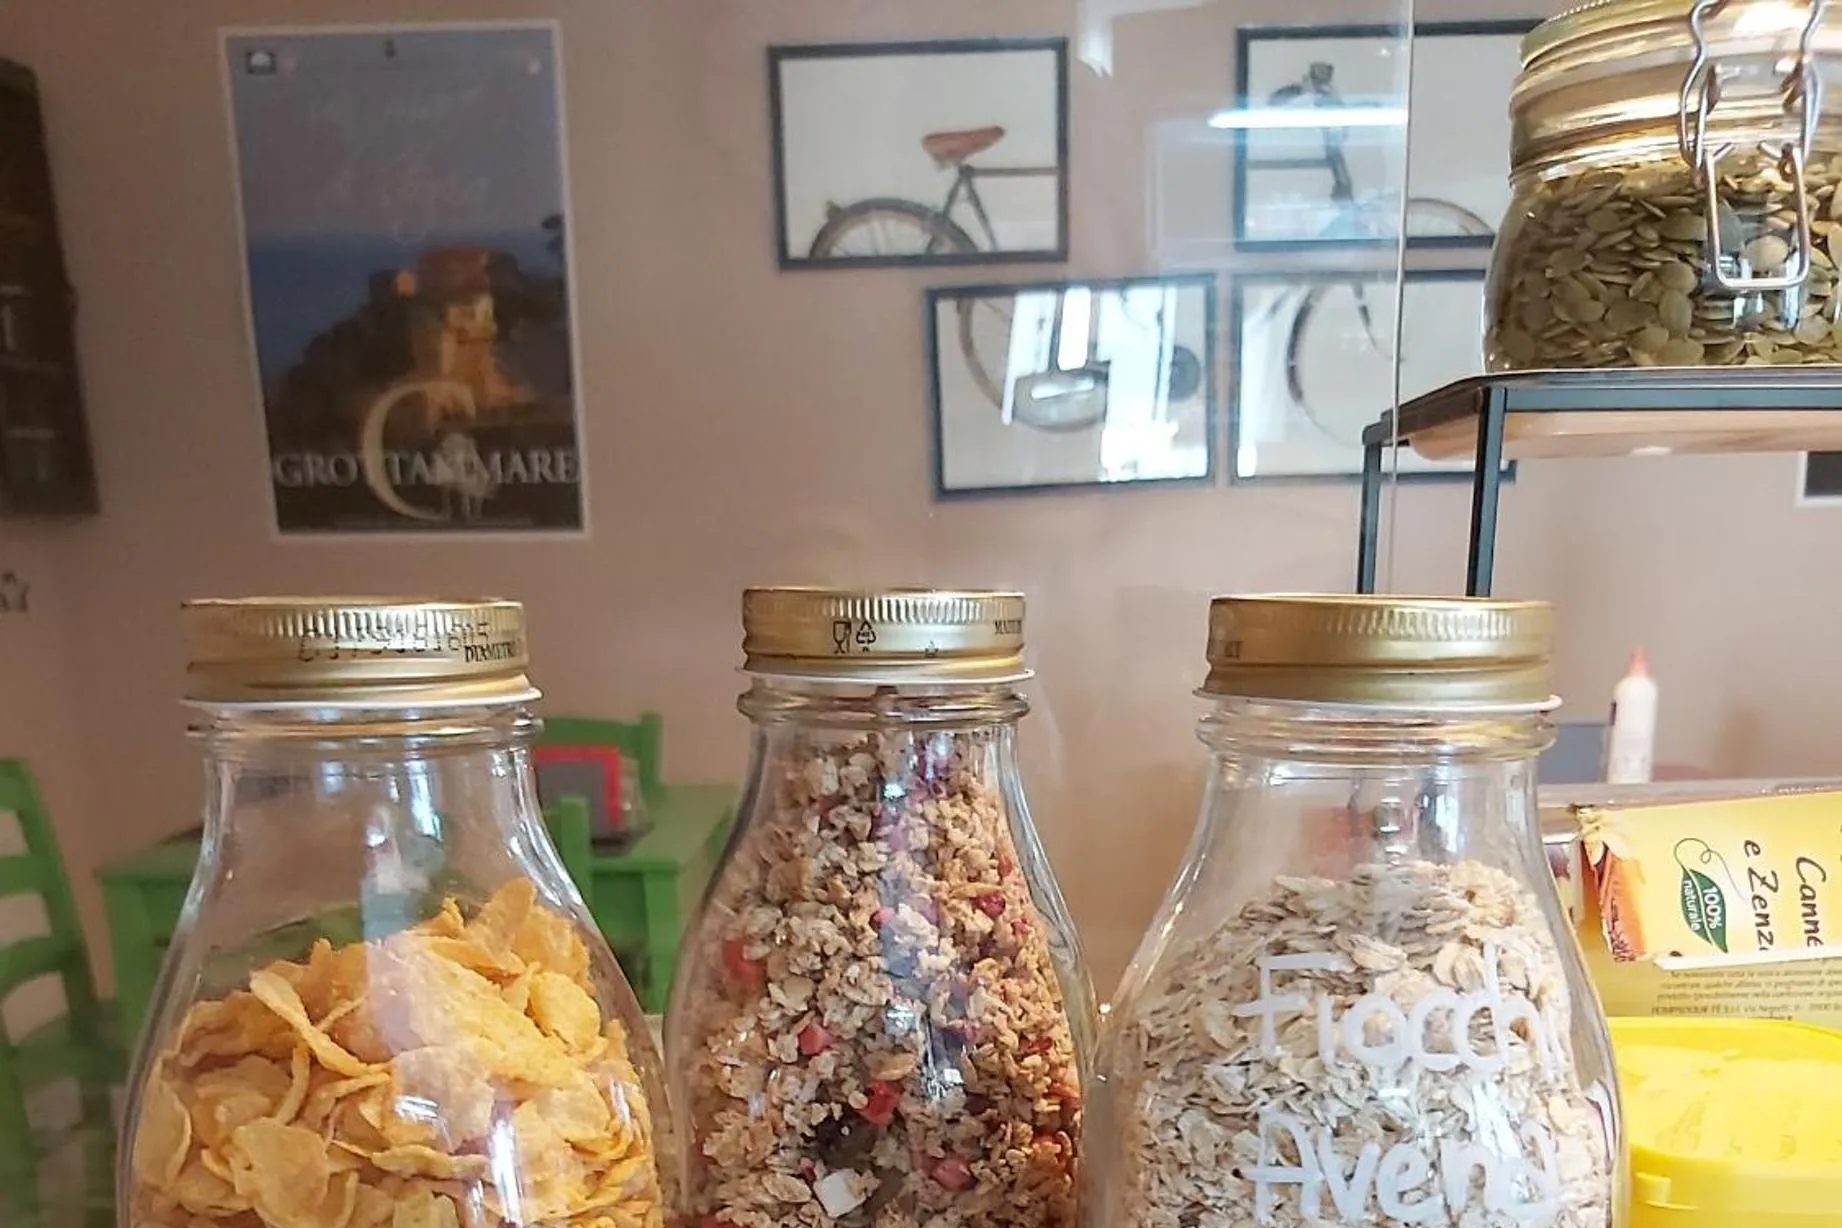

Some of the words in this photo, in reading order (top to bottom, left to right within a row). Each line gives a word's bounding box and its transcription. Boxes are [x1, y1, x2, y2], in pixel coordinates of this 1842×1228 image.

[1683, 880, 1701, 931] naturale
[1702, 886, 1722, 929] 100%
[1747, 867, 1779, 951] Zenz
